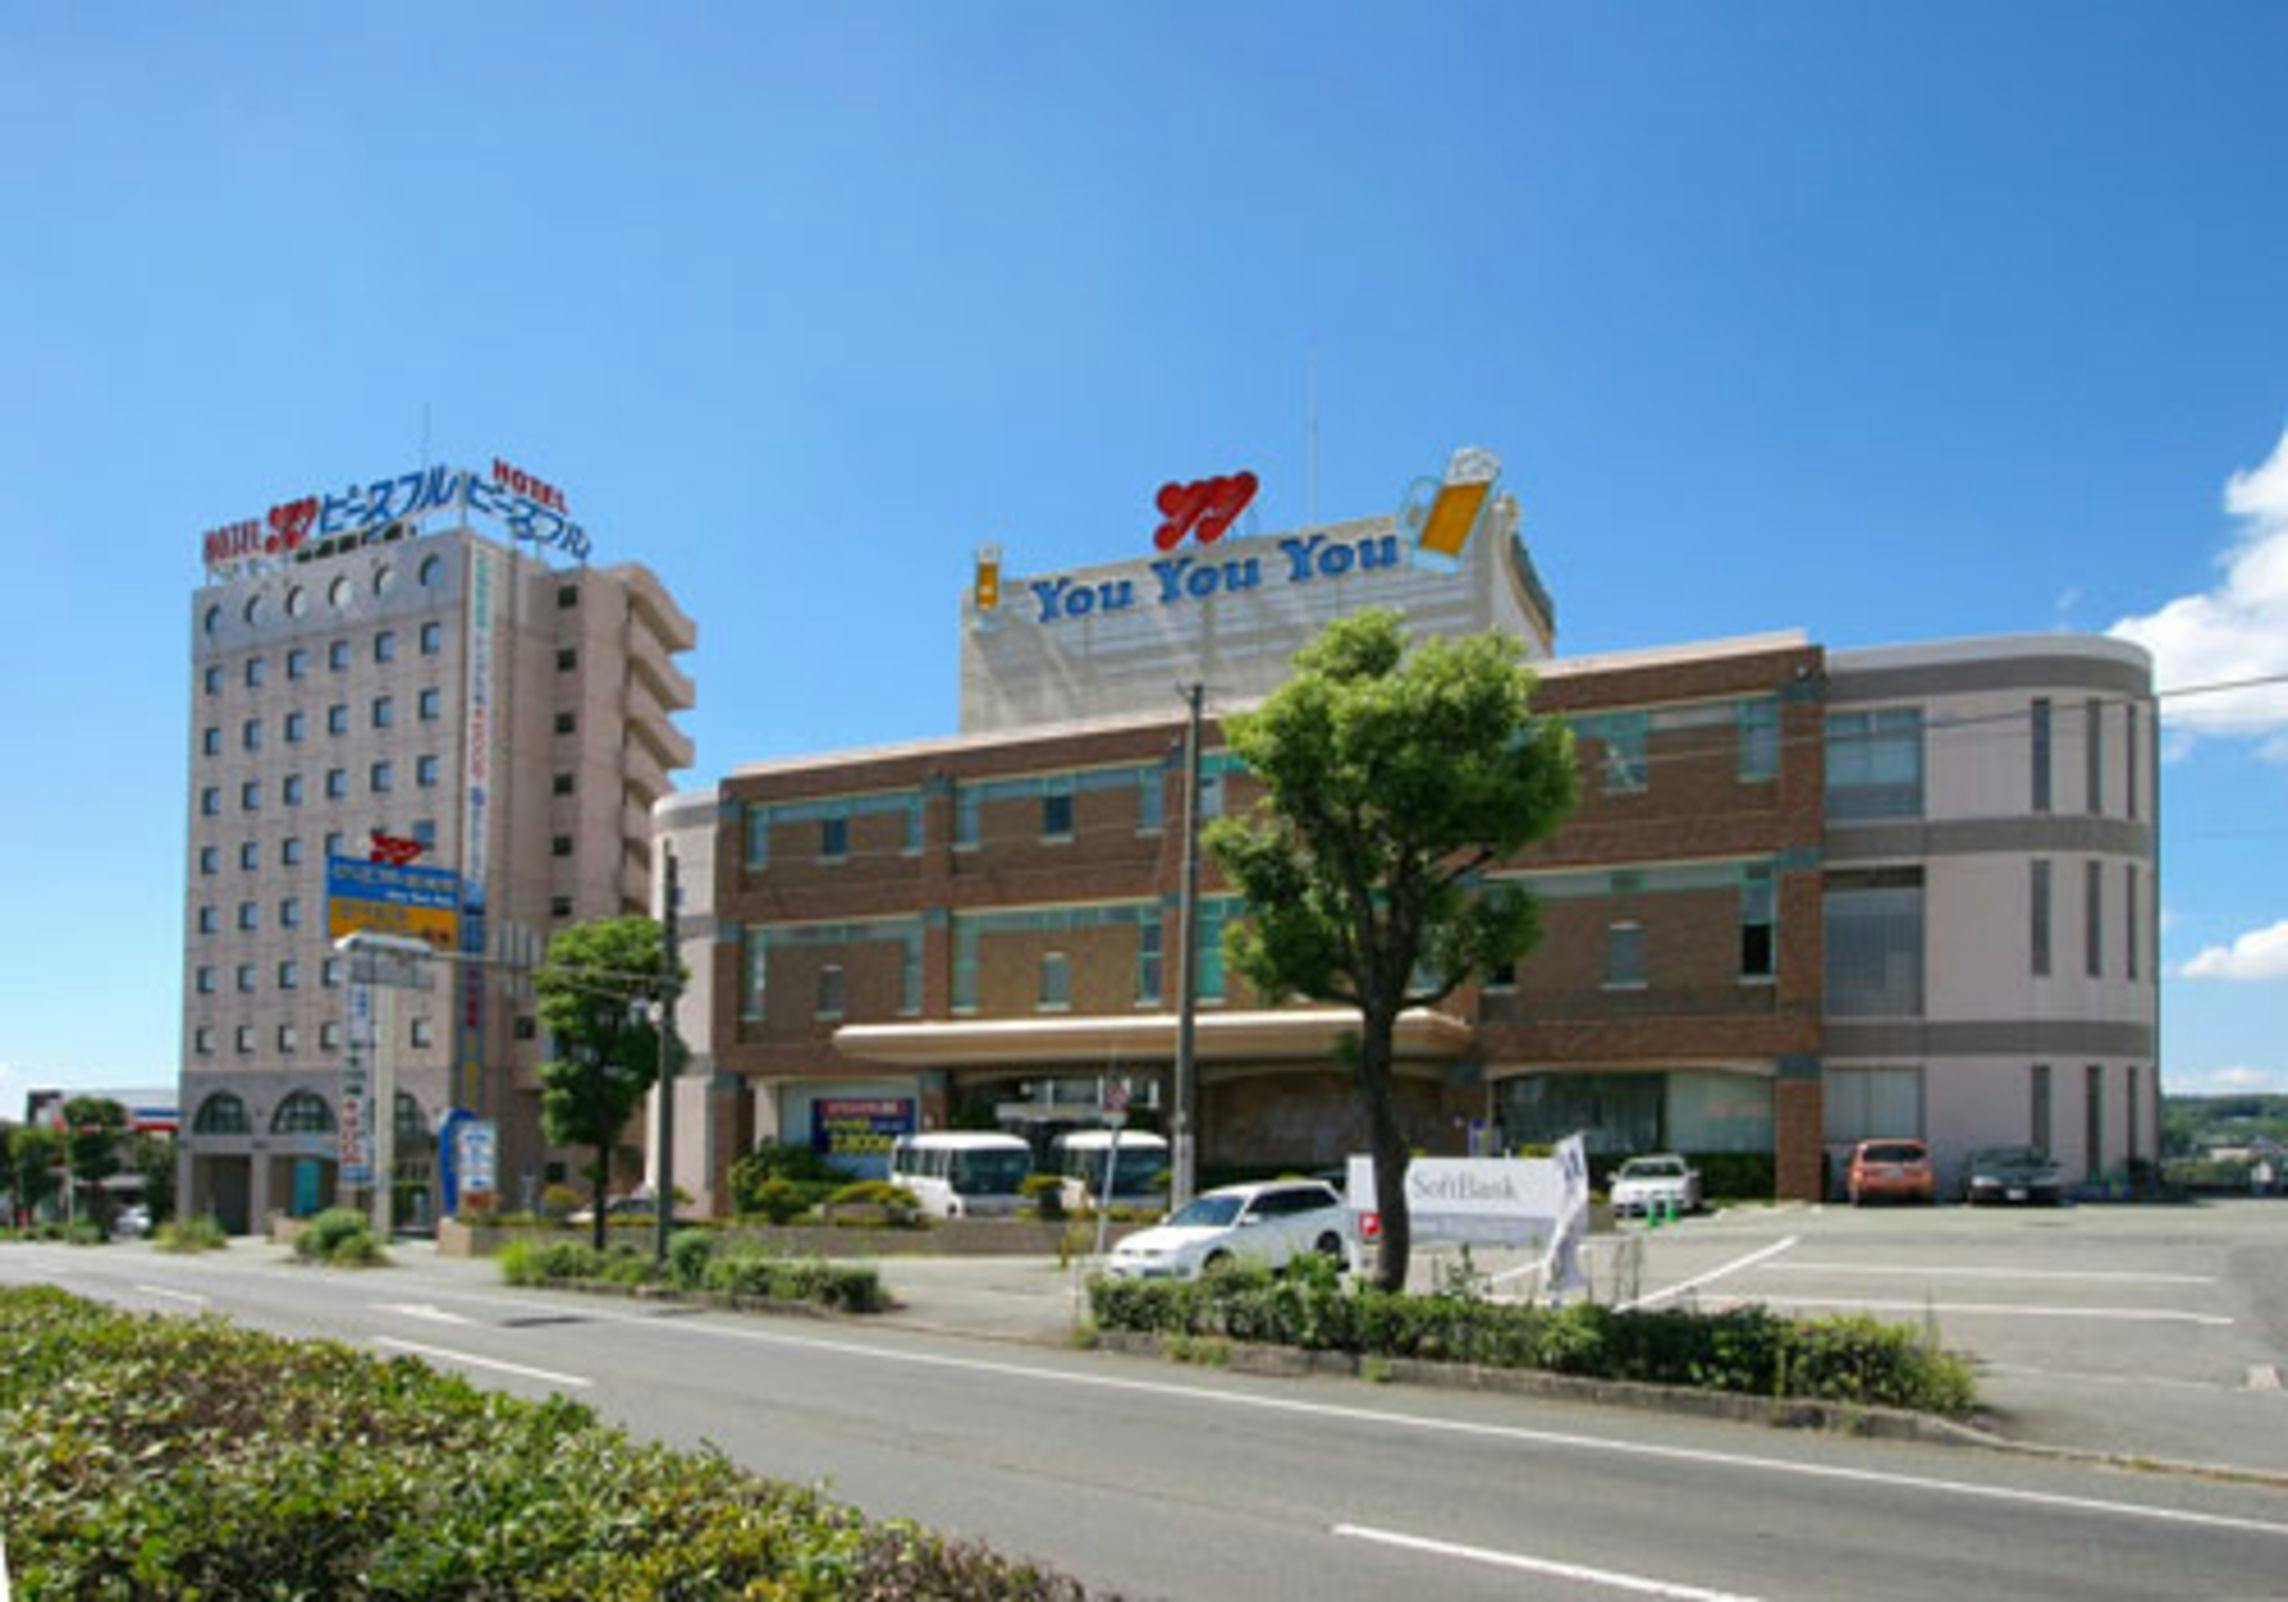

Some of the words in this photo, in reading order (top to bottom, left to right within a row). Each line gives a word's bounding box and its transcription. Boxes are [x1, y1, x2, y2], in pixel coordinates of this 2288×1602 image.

[491, 457, 567, 516] HOTEL
[1031, 575, 1135, 624] You
[1150, 555, 1262, 605] You
[1278, 533, 1399, 584] You
[1412, 1171, 1517, 1201] SoftBank
